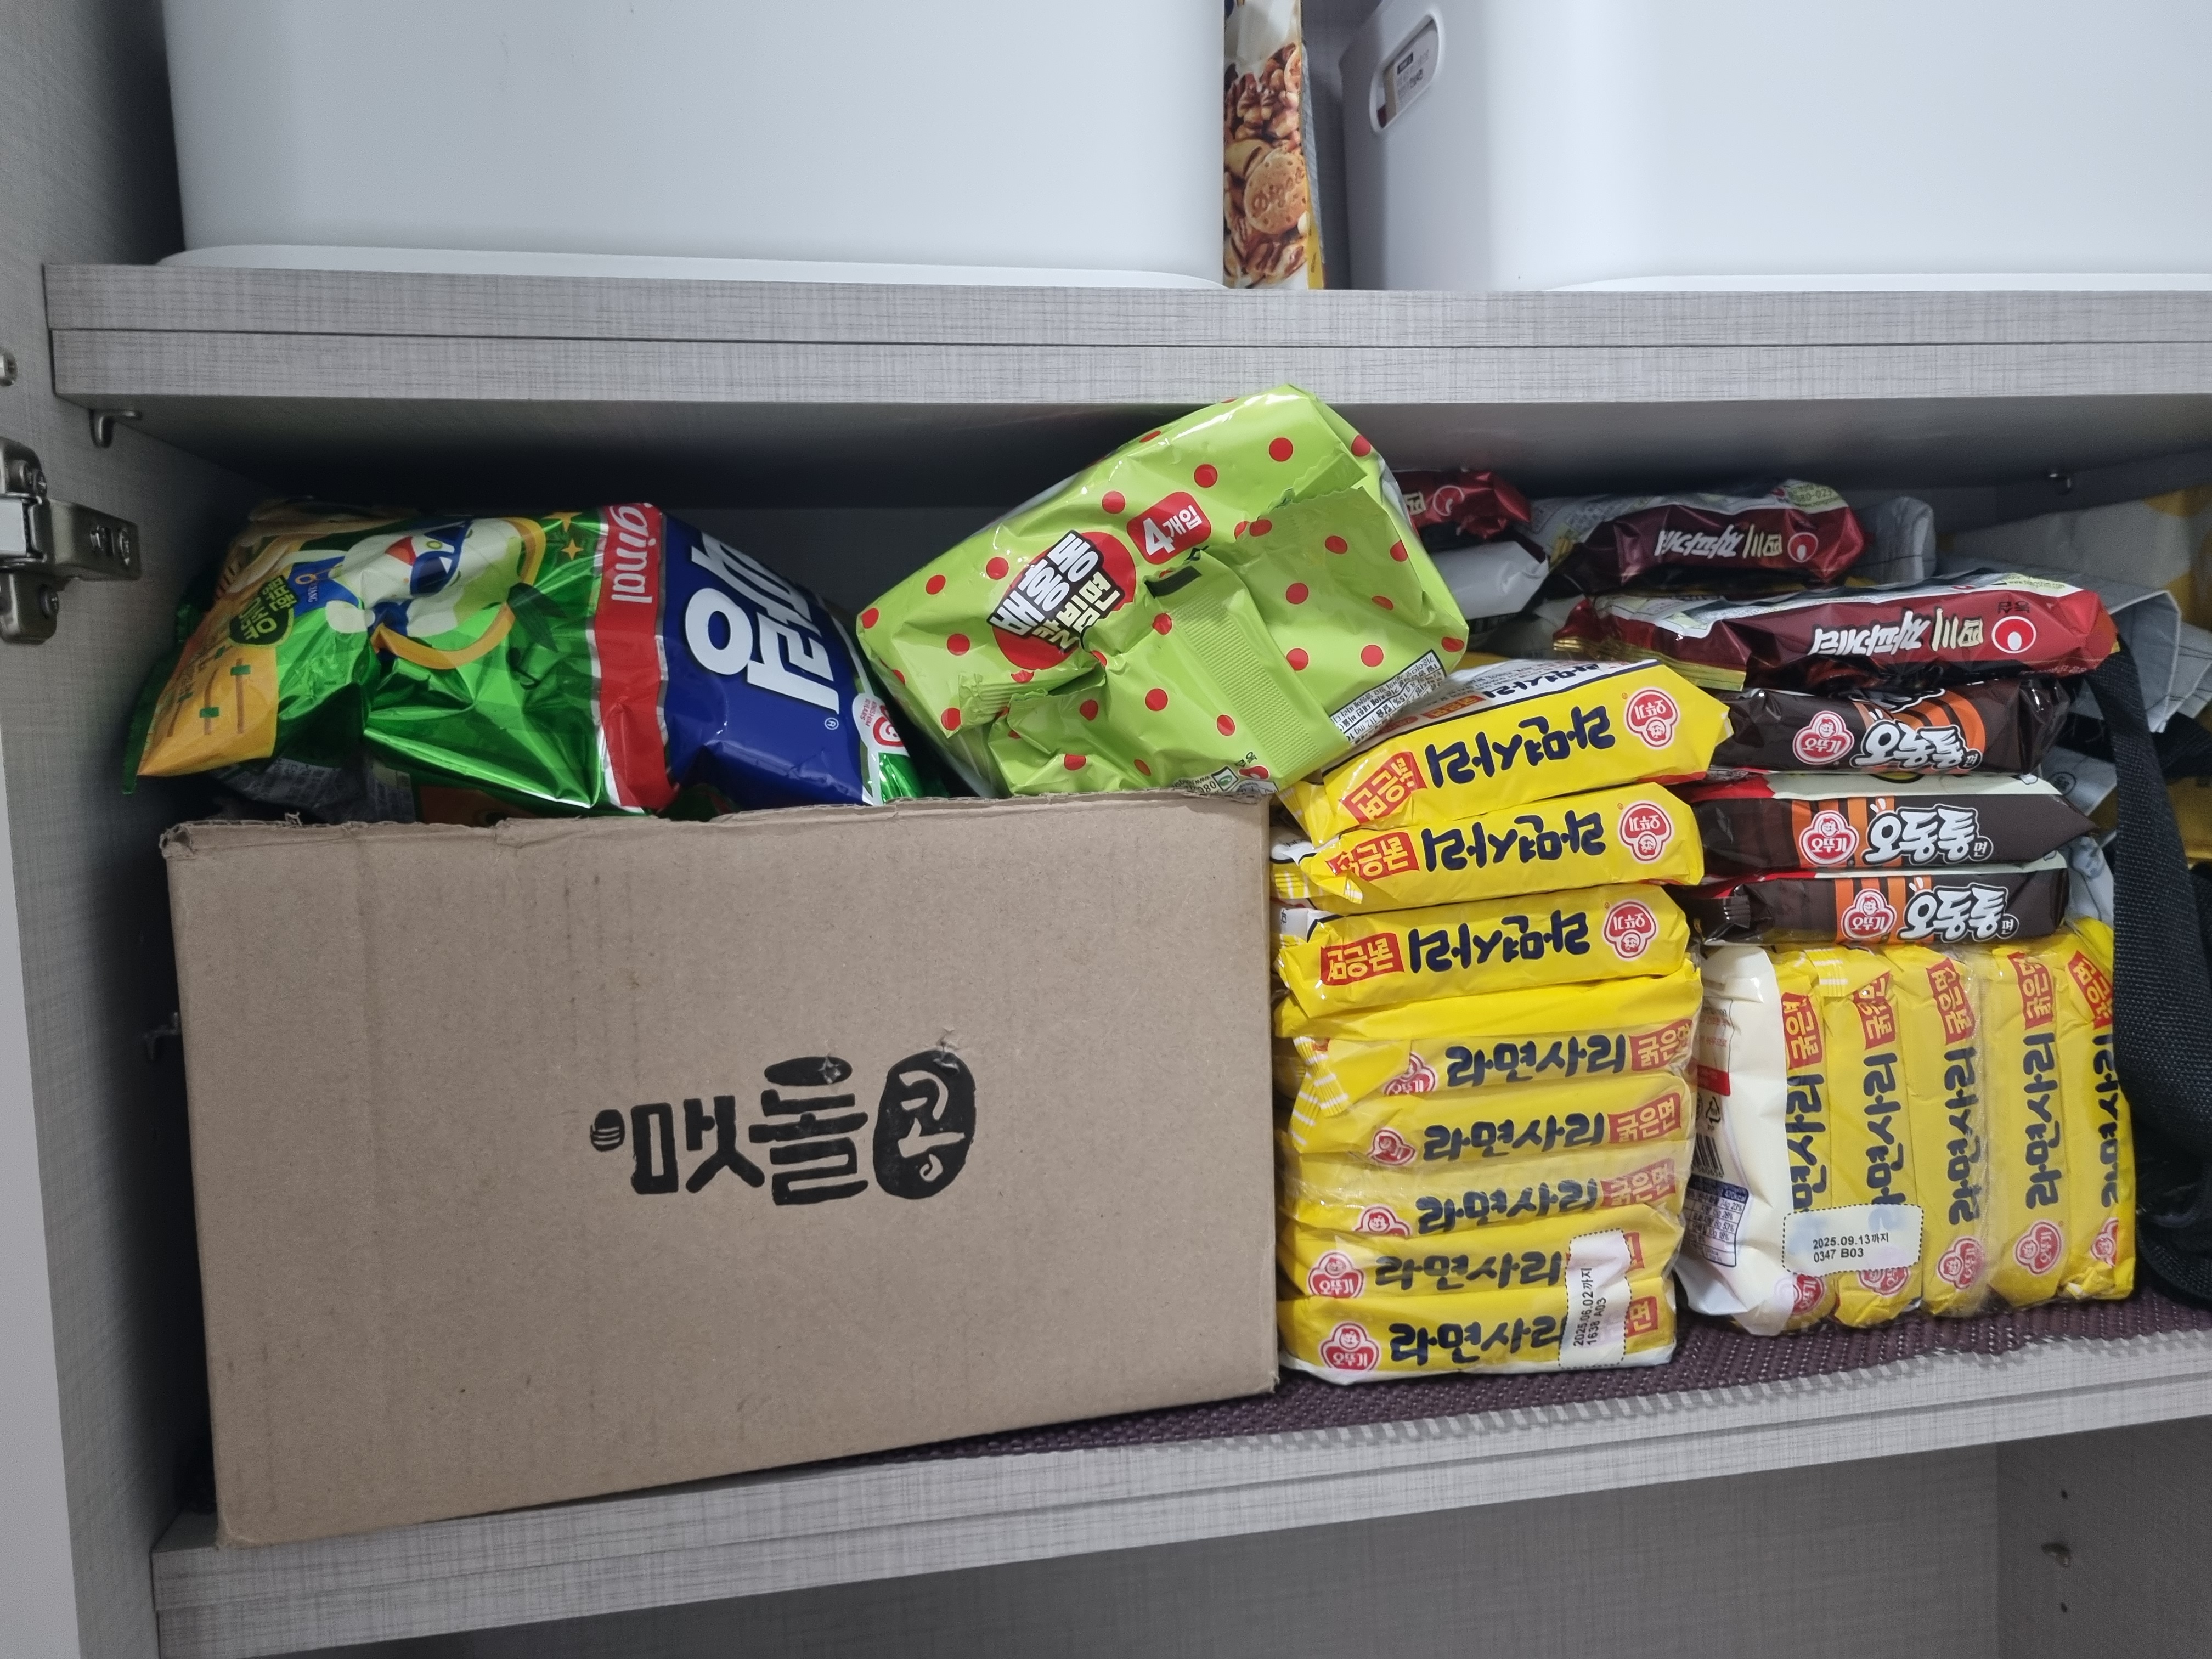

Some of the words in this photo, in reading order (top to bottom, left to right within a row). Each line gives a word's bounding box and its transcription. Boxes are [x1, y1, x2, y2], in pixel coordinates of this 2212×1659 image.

[1143, 505, 1202, 556] 4개입
[989, 533, 1098, 636] 배홍동
[1997, 601, 2030, 614] 농심
[1809, 610, 1932, 657] 짜파게티
[1355, 703, 1372, 718] 대한
[1375, 703, 1392, 719] 칼슘
[1392, 692, 1409, 706] 15%
[1636, 701, 1668, 721] 오뚜기
[1353, 723, 1366, 735] mg
[1365, 715, 1378, 727] 112
[1426, 706, 1616, 788] 라면사리
[1803, 736, 1843, 755] 오뚜기
[1421, 810, 1606, 872] 라면사리
[1632, 815, 1661, 832] 오뚜기
[1809, 837, 1847, 854] 오뚜기
[1613, 913, 1646, 930] 오뚜기
[1850, 916, 1886, 930] 오뚜기
[1325, 936, 1395, 981] 굵은면
[1409, 910, 1590, 974] 라면사리
[1931, 962, 1972, 1040] 굵은면
[2017, 956, 2052, 1026] 굵은면
[1446, 1034, 1626, 1087] 라면사리
[1636, 1022, 1691, 1070] 굵은면
[1423, 1112, 1605, 1162] 라면사리
[1617, 1096, 1676, 1141] 굵은면
[1945, 1048, 1980, 1225] 라면사리
[2023, 1033, 2062, 1209] 라면사리
[1787, 1075, 1827, 1213] 면사리
[1415, 1178, 1599, 1235] 라면사리
[1611, 1161, 1674, 1205] 굵은면
[1813, 1233, 1889, 1250] 2025.09.13까지
[1813, 1250, 1837, 1262] 0347
[1840, 1248, 1864, 1259] B03
[2040, 1231, 2053, 1262] 오뚜기
[1319, 1279, 1354, 1296] 오뚜기
[1375, 1251, 1562, 1291] 라면사리
[1573, 1268, 1593, 1346] 2025.06.02까지
[1587, 1320, 1600, 1345] 1638
[1594, 1297, 1606, 1317] A03
[1333, 1351, 1368, 1368] 오뚜기
[1389, 1314, 1568, 1366] 라면사리
